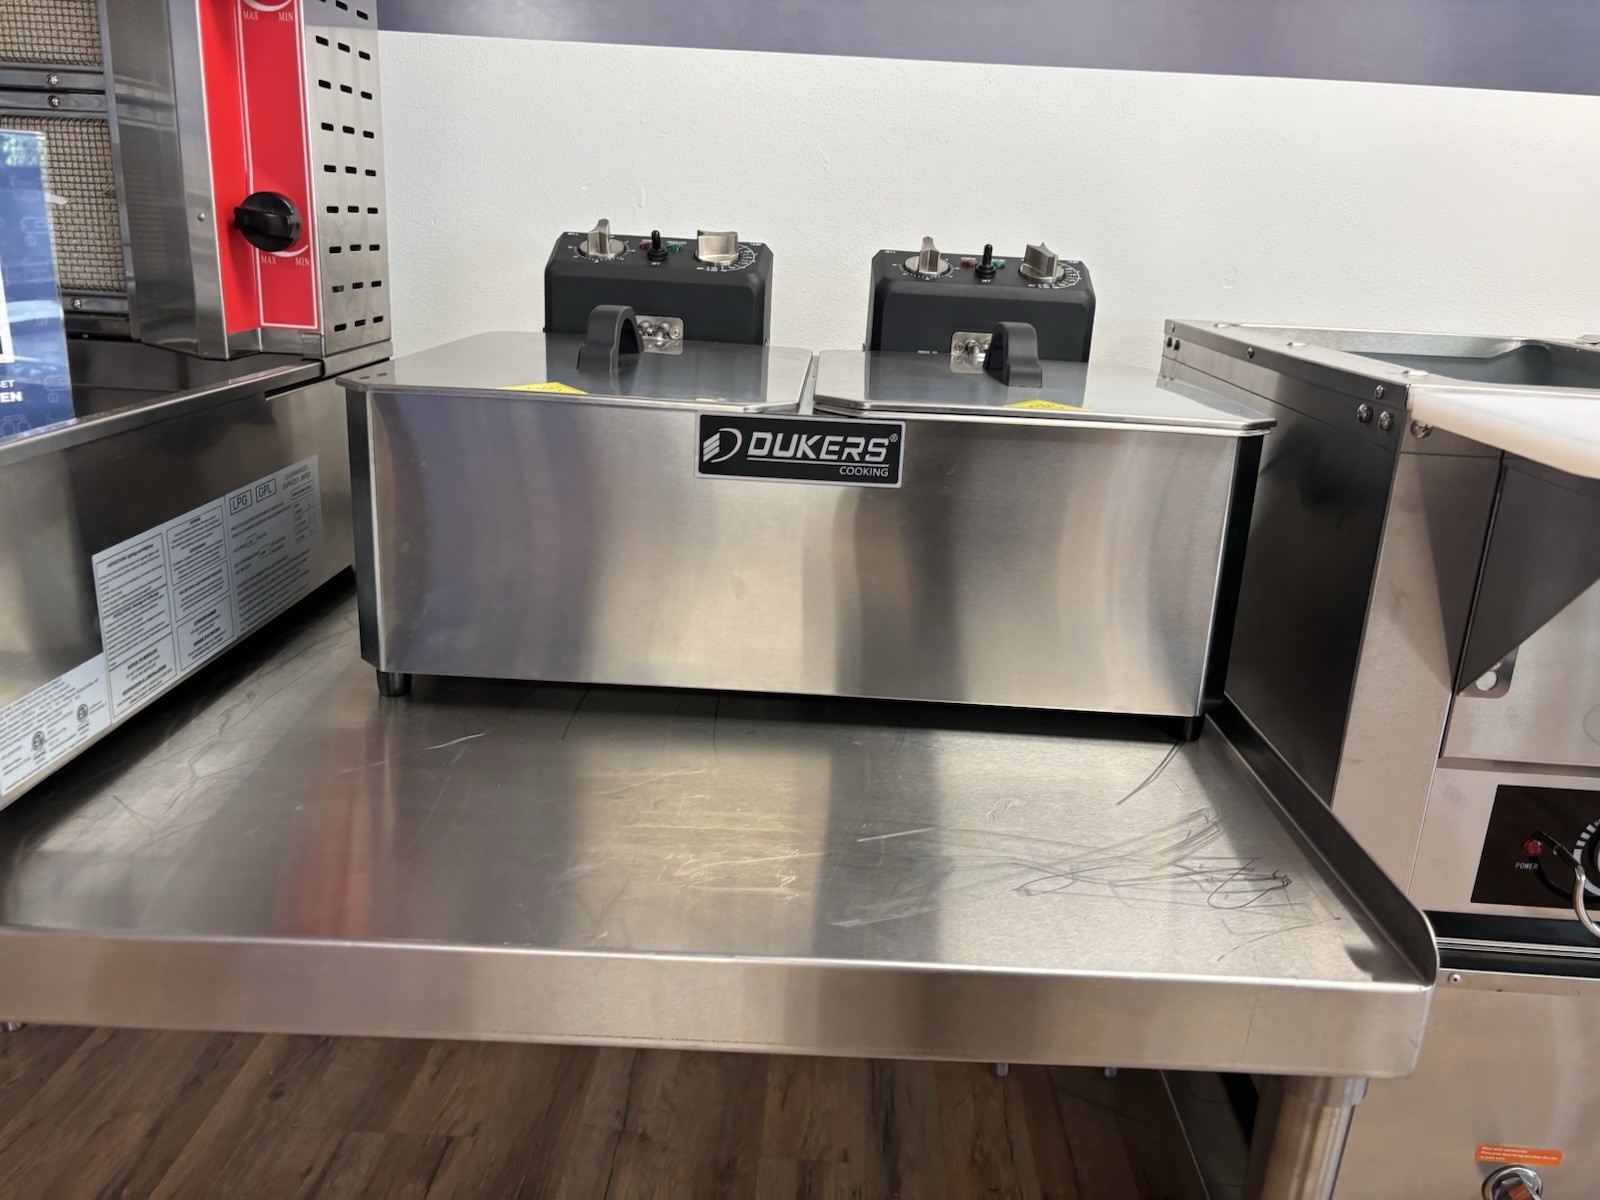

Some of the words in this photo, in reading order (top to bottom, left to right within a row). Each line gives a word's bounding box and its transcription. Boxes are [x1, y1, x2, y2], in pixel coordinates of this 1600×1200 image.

[243, 11, 259, 20] MAX
[278, 12, 294, 22] MIN
[261, 255, 277, 264] MAX
[295, 257, 310, 266] MIN
[0, 380, 15, 389] ET
[839, 466, 889, 478] COOKING
[232, 495, 248, 511] LPG
[258, 483, 273, 498] GPL
[1515, 861, 1539, 870] POWER
